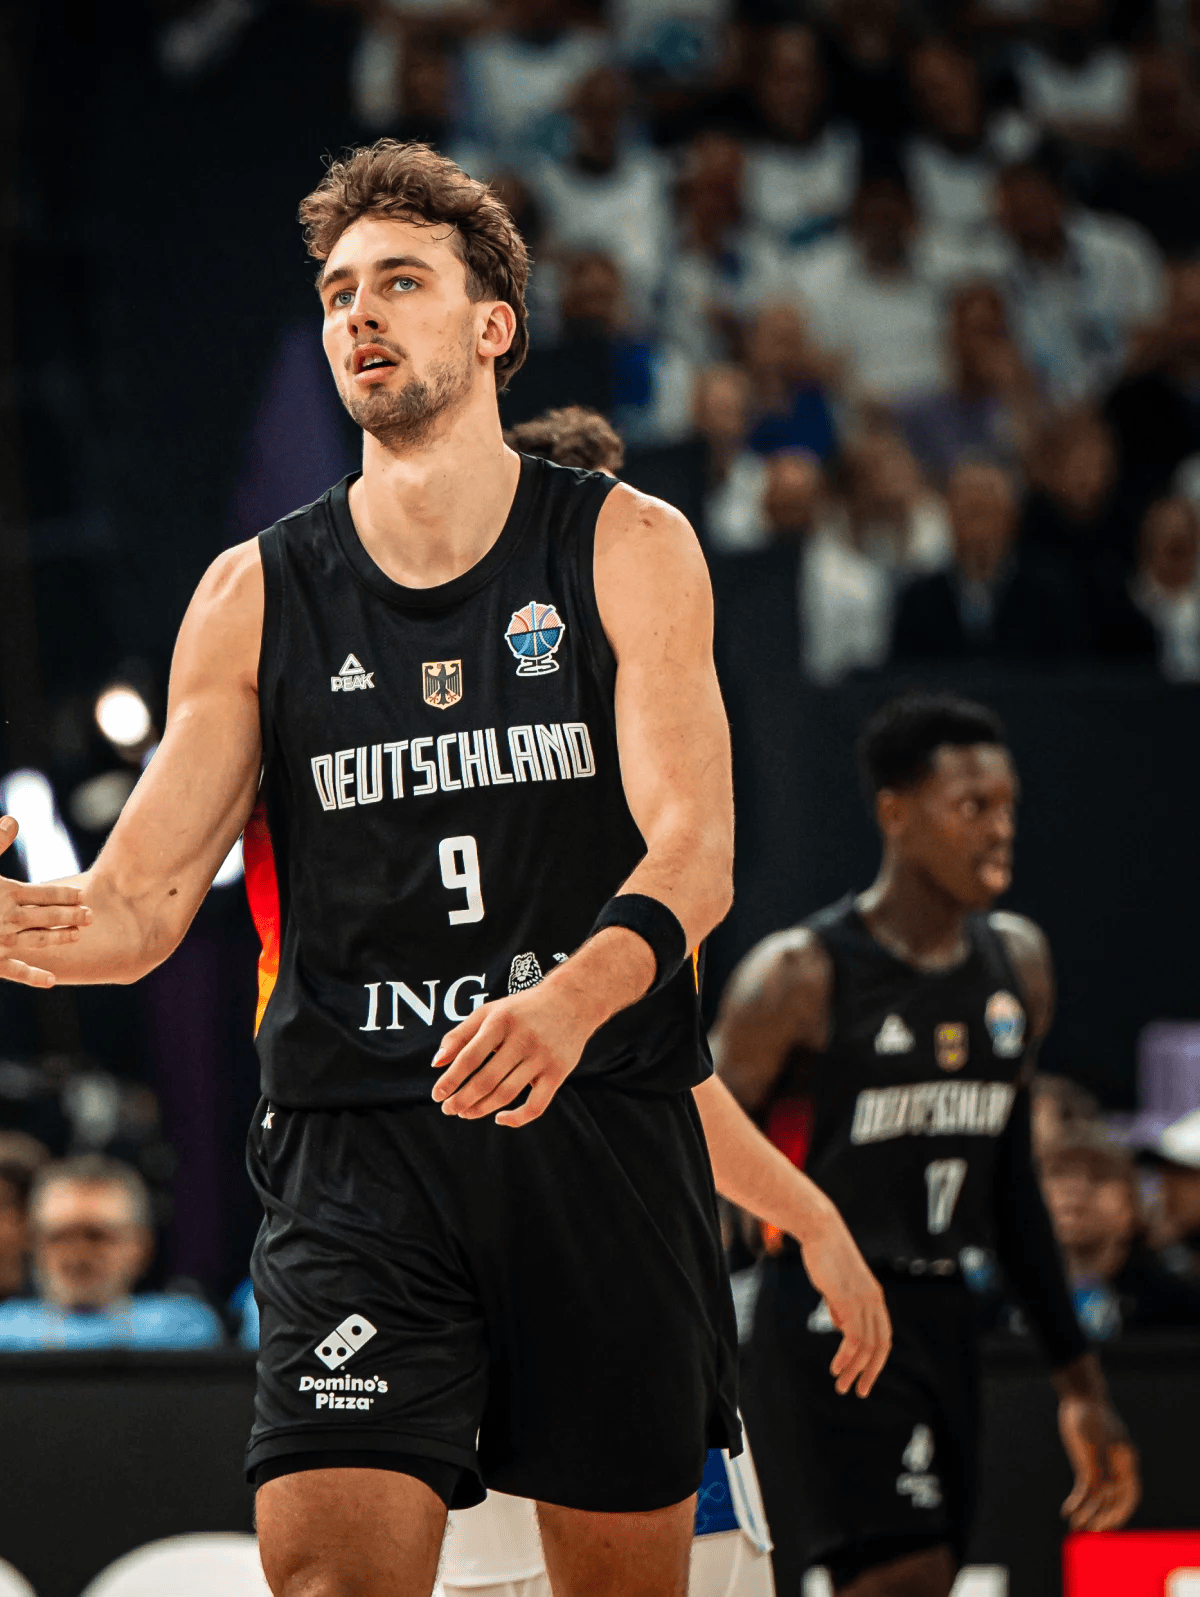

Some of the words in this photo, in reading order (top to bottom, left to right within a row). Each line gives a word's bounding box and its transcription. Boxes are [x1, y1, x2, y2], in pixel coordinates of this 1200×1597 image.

[330, 671, 375, 692] PEAK
[310, 722, 596, 811] DEUTSCHLAND
[438, 835, 485, 926] 9
[359, 973, 490, 1031] ING
[925, 1158, 968, 1234] 17
[298, 1373, 389, 1393] Domino's
[315, 1392, 370, 1411] Pizza
